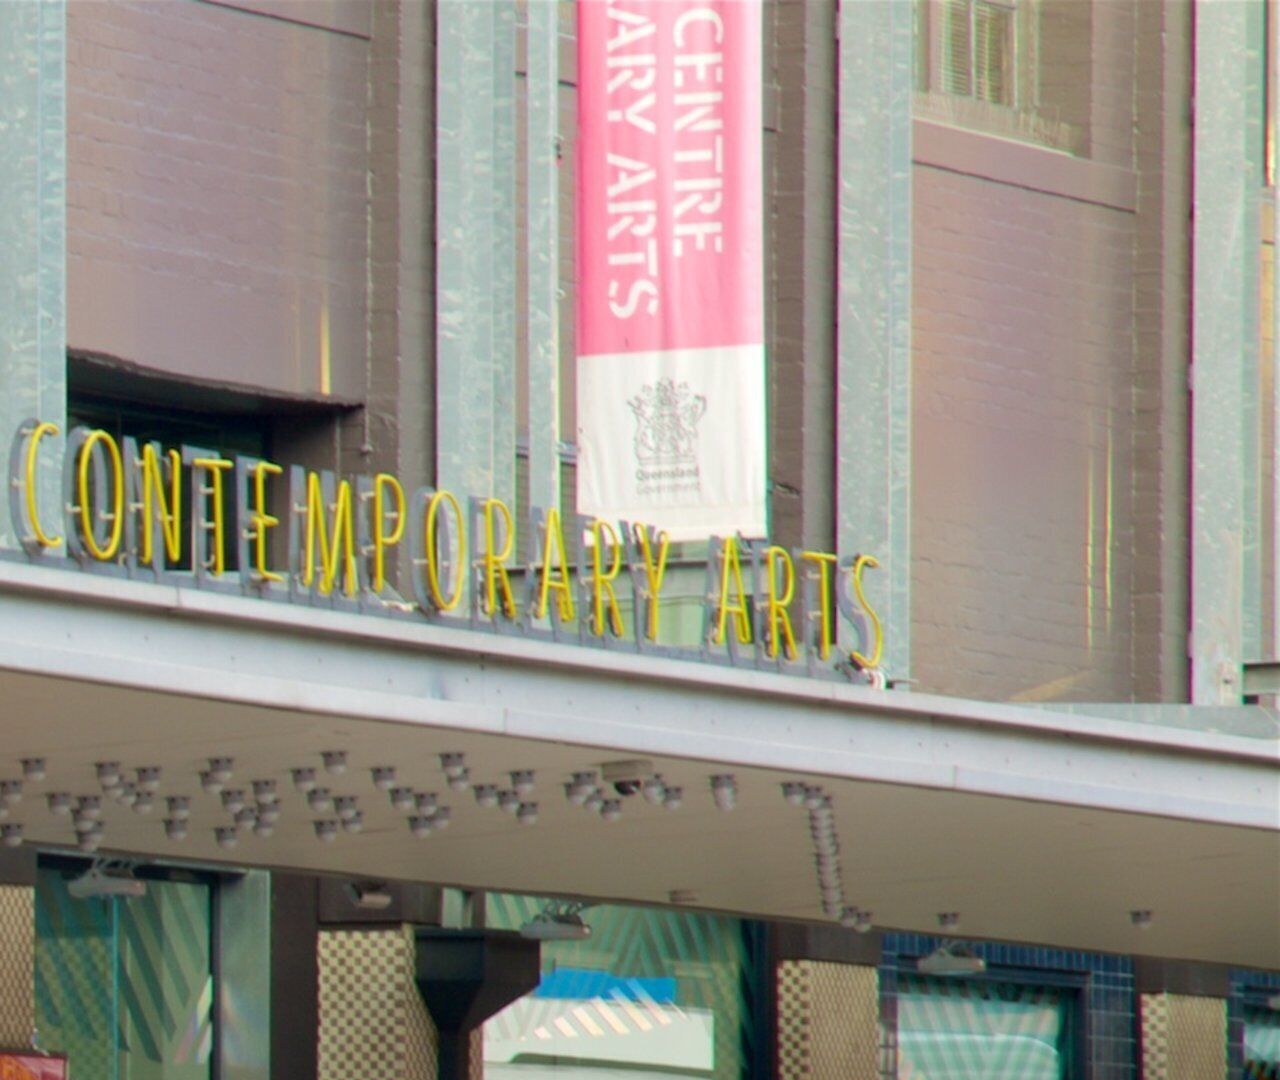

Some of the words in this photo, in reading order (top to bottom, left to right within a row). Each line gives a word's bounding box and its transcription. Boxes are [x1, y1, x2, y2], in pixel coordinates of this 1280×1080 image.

[605, 152, 659, 319] ARTS
[672, 7, 724, 257] CENTRE
[10, 417, 670, 643] CONTEMPORARY
[702, 533, 882, 670] ARTS
[634, 465, 701, 481] Queensland
